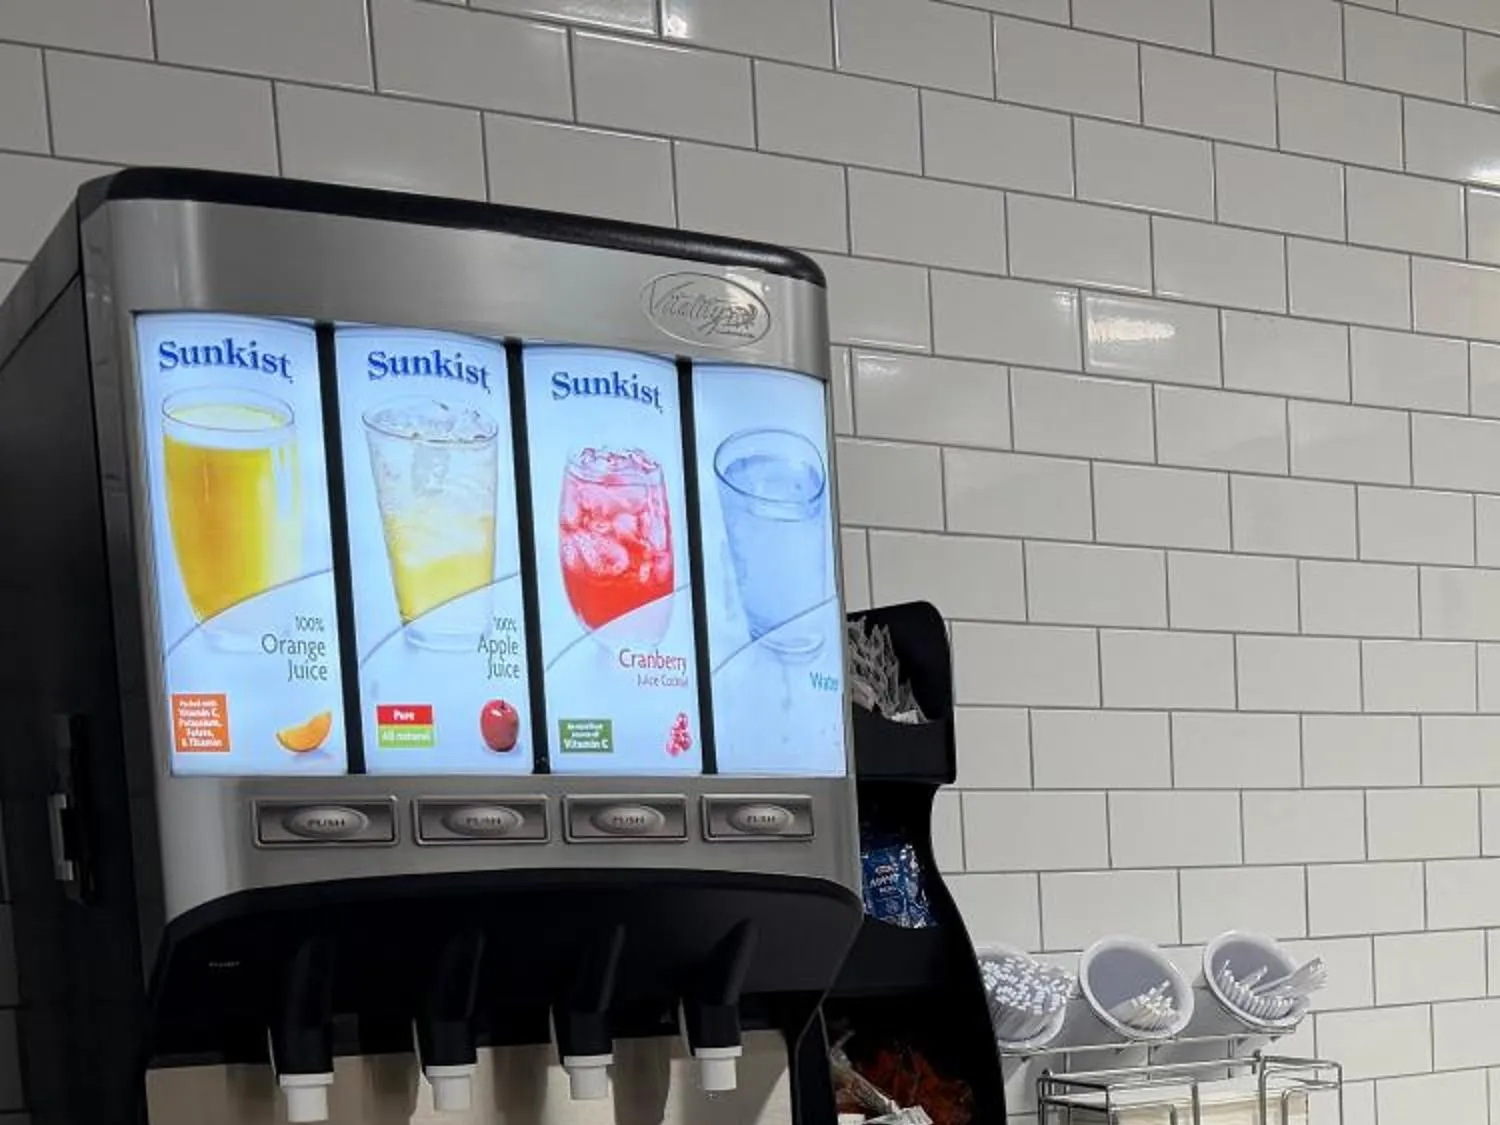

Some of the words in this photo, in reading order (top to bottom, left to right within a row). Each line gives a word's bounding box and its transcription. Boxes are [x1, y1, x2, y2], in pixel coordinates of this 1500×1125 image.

[159, 337, 292, 383] Sunkist
[367, 349, 491, 394] Sunkist
[551, 370, 663, 413] Sunkist
[261, 633, 326, 662] Orange
[478, 633, 519, 662] Apple
[619, 648, 687, 676] Cranberry
[287, 659, 328, 682] Juice
[487, 659, 520, 680] Juice
